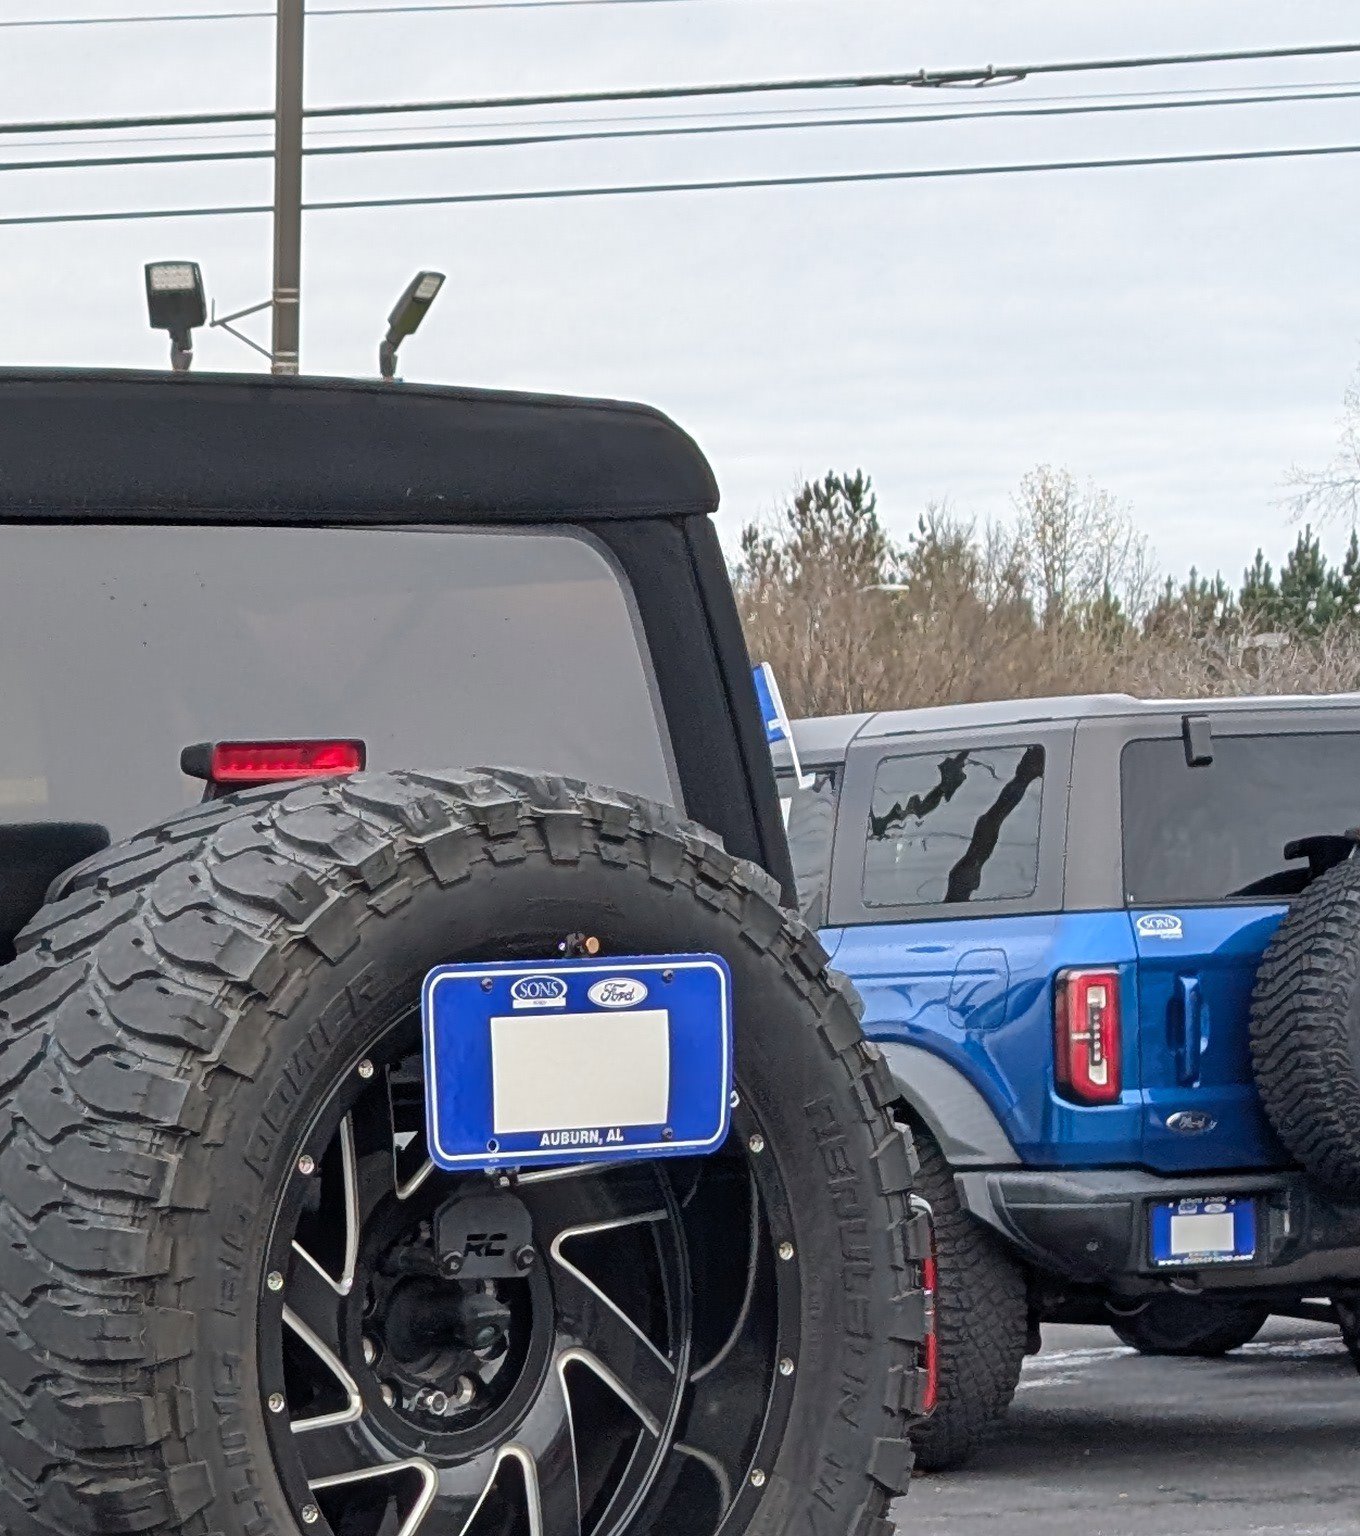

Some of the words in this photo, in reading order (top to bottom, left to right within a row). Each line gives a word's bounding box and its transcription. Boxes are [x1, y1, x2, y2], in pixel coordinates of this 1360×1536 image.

[519, 981, 560, 998] SONS
[600, 982, 636, 1002] Ford
[540, 1129, 603, 1146] AUBURN,
[606, 1127, 624, 1142] AL
[463, 1232, 508, 1257] RC
